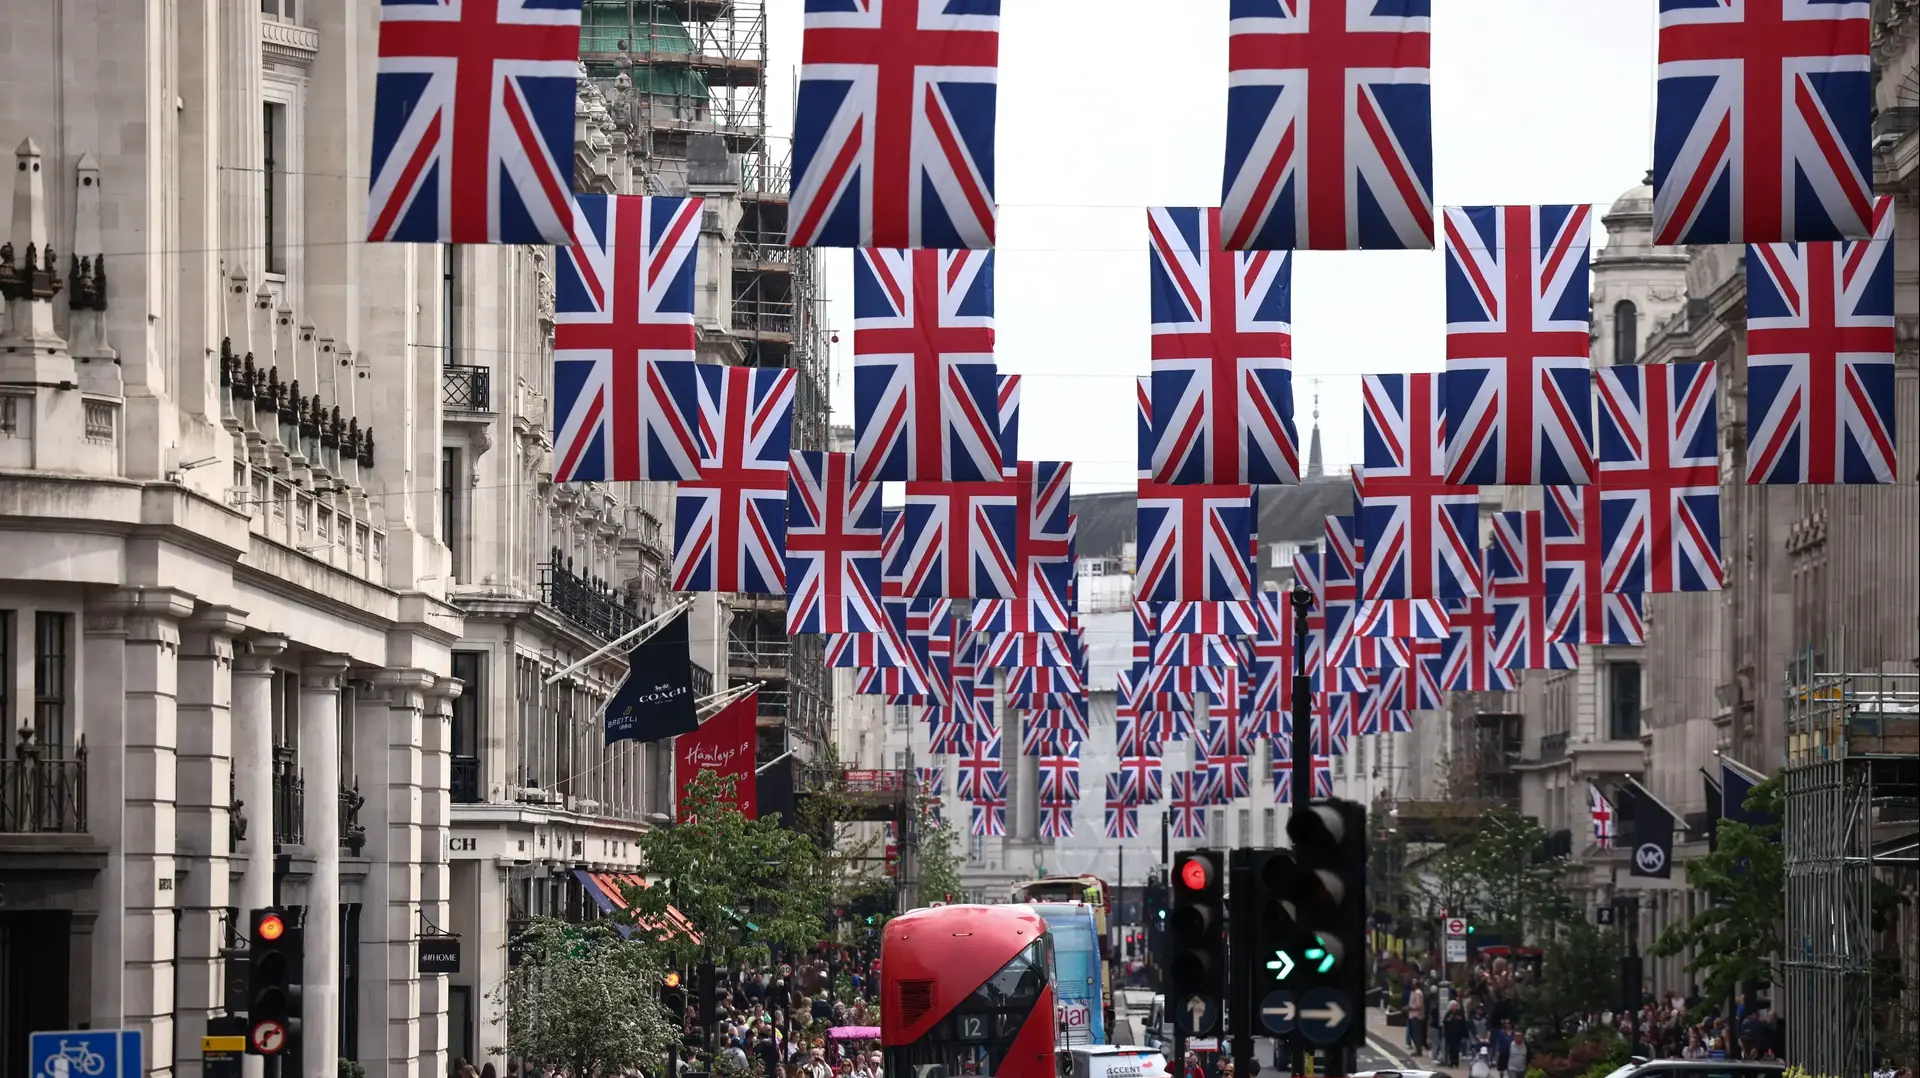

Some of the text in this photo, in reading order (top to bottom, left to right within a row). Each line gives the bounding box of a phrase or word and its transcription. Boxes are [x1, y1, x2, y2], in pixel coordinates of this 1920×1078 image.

[639, 686, 687, 703] COACH
[684, 742, 735, 767] Hamleys
[432, 953, 457, 962] HOME
[964, 1017, 982, 1037] 12
